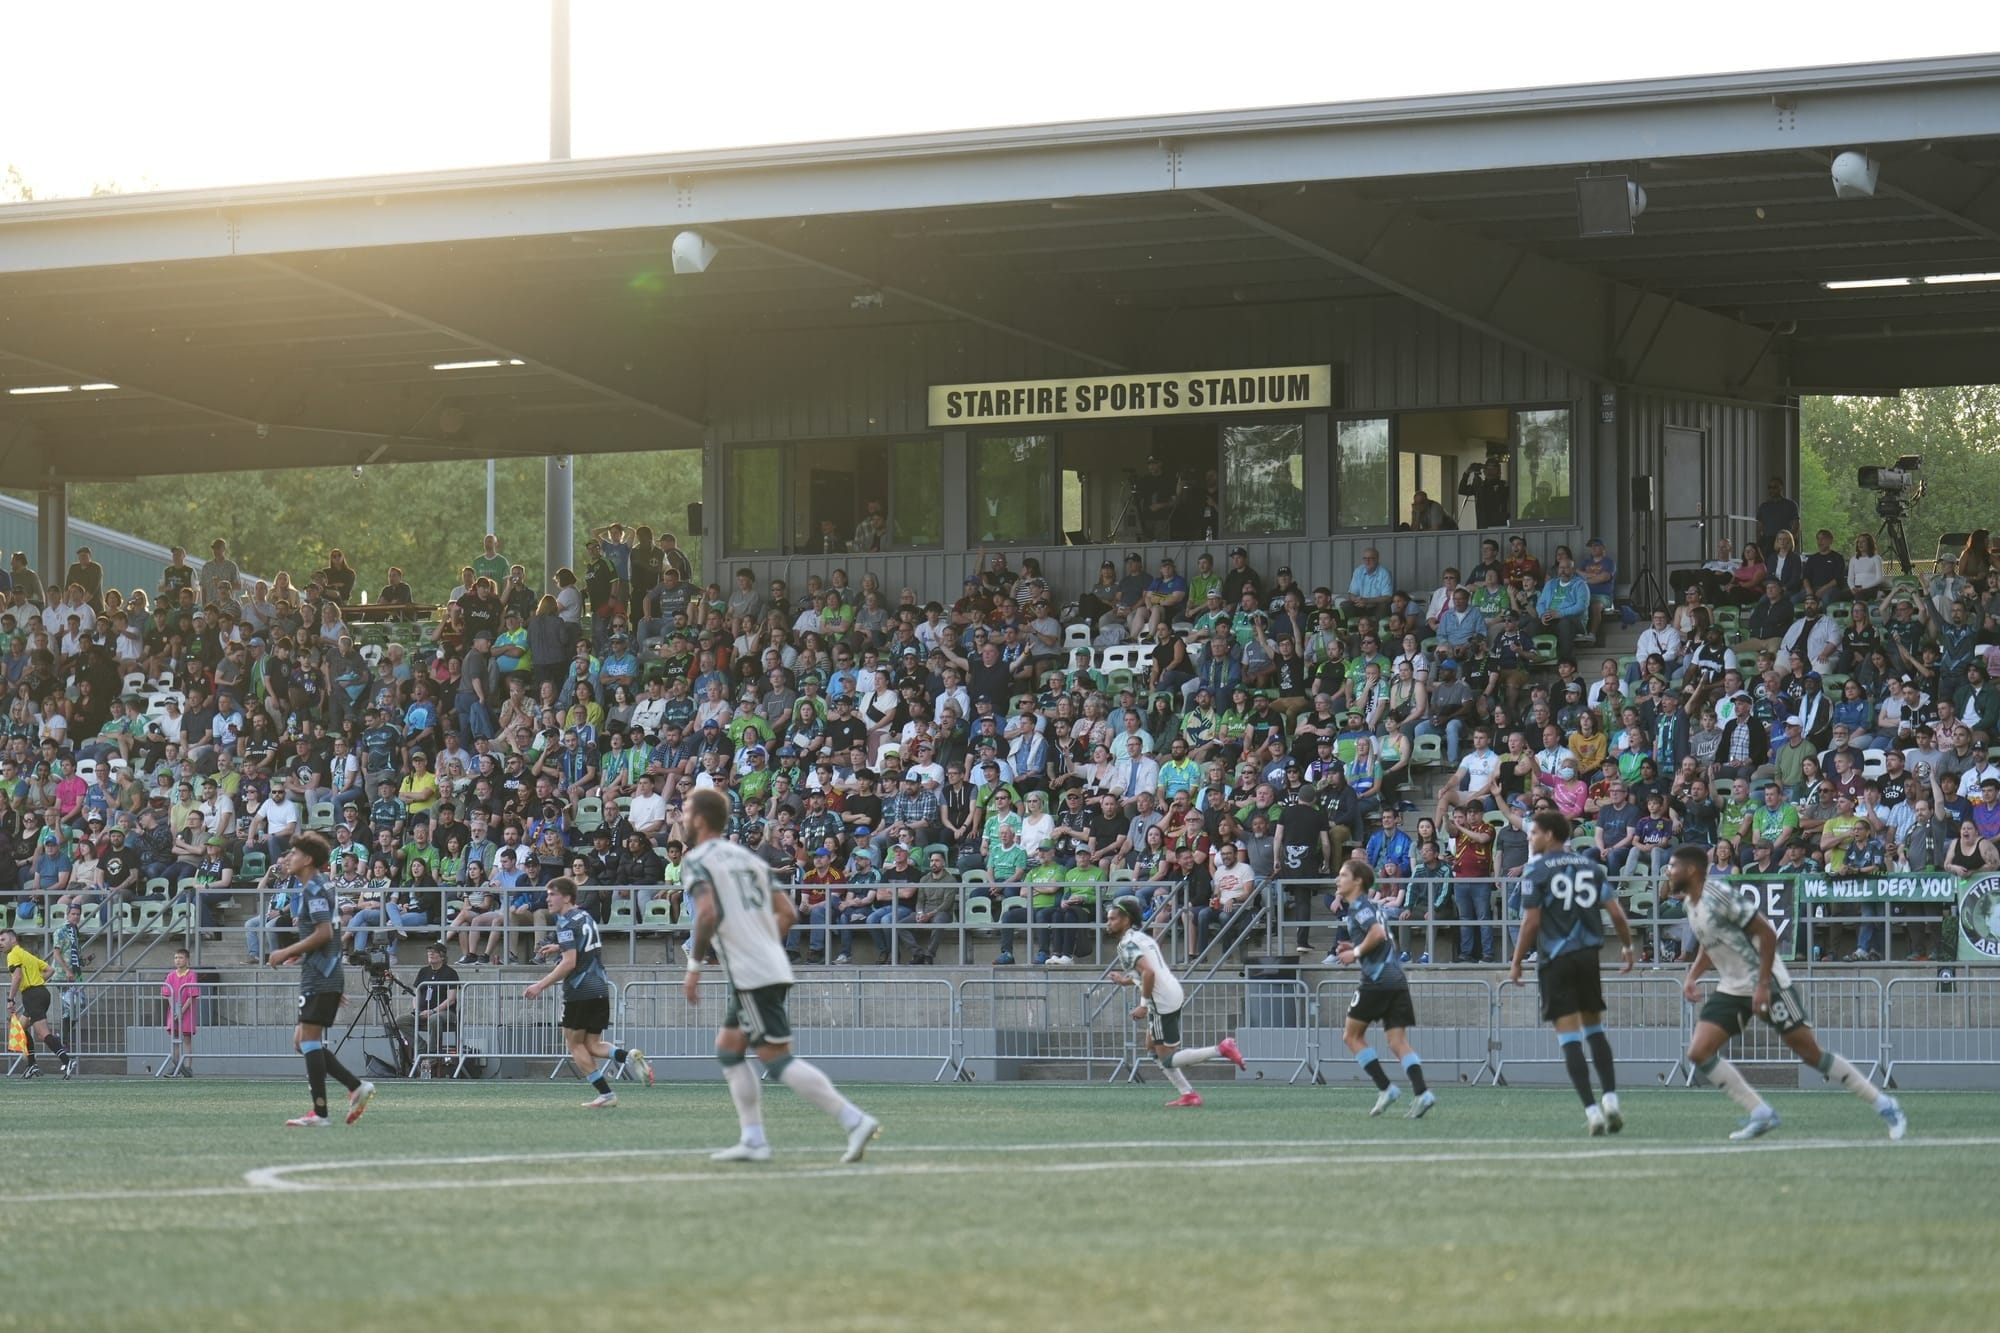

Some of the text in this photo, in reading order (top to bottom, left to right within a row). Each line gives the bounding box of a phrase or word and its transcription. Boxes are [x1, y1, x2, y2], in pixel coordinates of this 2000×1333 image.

[946, 374, 1311, 418] STARFIRE SPORTS STADIUM
[1550, 870, 1598, 911] 95
[1804, 879, 1828, 898] WE
[1832, 879, 1873, 898] WILL
[1877, 878, 1916, 898] DEFY
[1970, 878, 2000, 899] THE
[1974, 938, 2000, 956] AR
